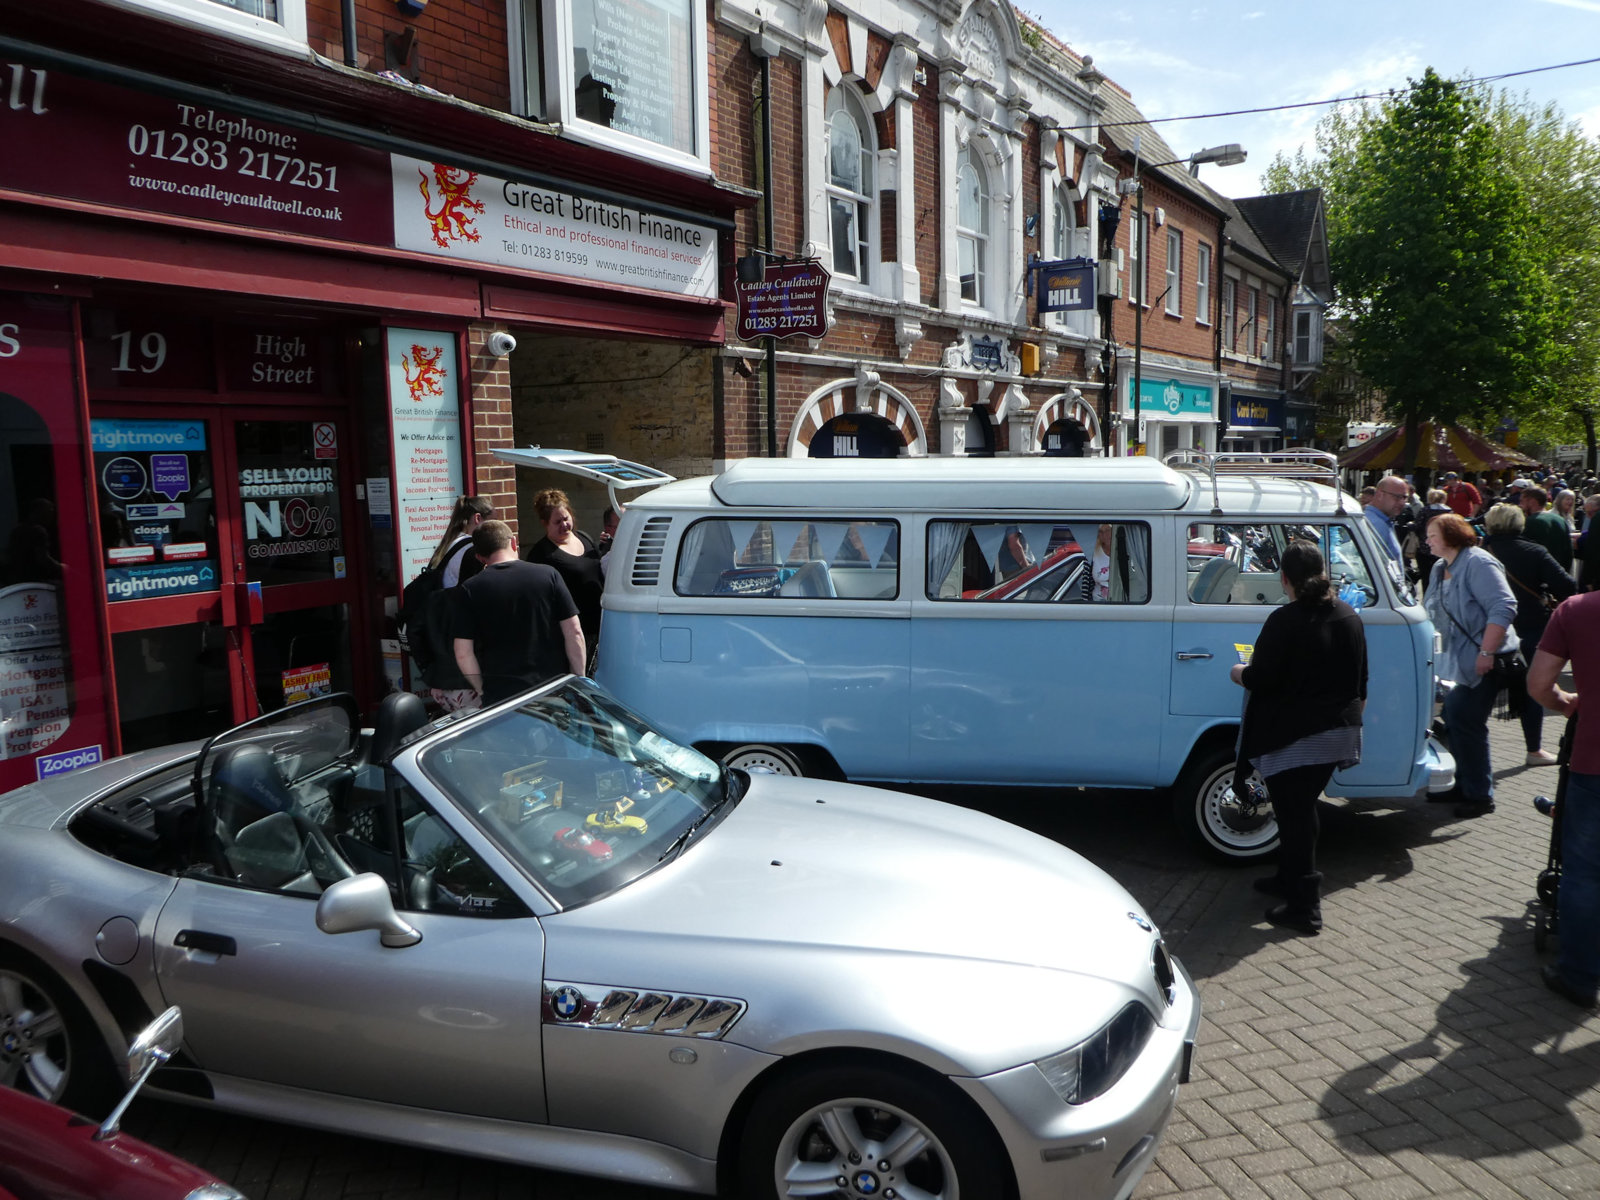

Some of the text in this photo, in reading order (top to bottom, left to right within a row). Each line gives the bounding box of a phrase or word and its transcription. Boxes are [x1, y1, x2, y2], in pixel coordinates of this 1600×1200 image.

[592, 54, 618, 72] Flexible
[967, 51, 995, 79] ARMS
[592, 69, 616, 88] Lasting
[602, 88, 631, 106] Property
[622, 109, 635, 121] And
[177, 104, 297, 150] Telephone:
[609, 119, 632, 133] Health
[640, 127, 664, 143] Welfare
[128, 124, 340, 193] 01283 217251
[128, 174, 343, 221] www.cadleycauldwell.co.uk
[502, 180, 701, 247] Great British Finance
[504, 214, 702, 266] Ethical and professional financial services
[502, 240, 705, 287] Tel: 01283 819599 www.greatbritishfinance.com
[774, 275, 822, 289] Cauldwell
[747, 291, 816, 303] Estate Agents Limited
[1047, 288, 1082, 306] HILL
[744, 314, 818, 330] 01283 217251
[110, 330, 167, 374] 19
[254, 334, 306, 362] High
[251, 361, 315, 384] Street
[394, 408, 458, 417] Great British Finance
[92, 429, 185, 449] rightmove
[833, 435, 860, 456] HILL
[410, 457, 449, 465] Re-Mortgages
[156, 474, 186, 483] Zoopla
[242, 467, 334, 485] SELL YOUR
[243, 482, 334, 497] PROPERTY FOR
[418, 505, 436, 513] Access
[408, 515, 428, 523] Pension
[134, 525, 169, 535] closed
[248, 538, 341, 559] COMMISSION
[107, 573, 199, 597] rightmove
[14, 614, 41, 625] British
[5, 657, 28, 666] Offer
[42, 752, 97, 773] Zoopla
